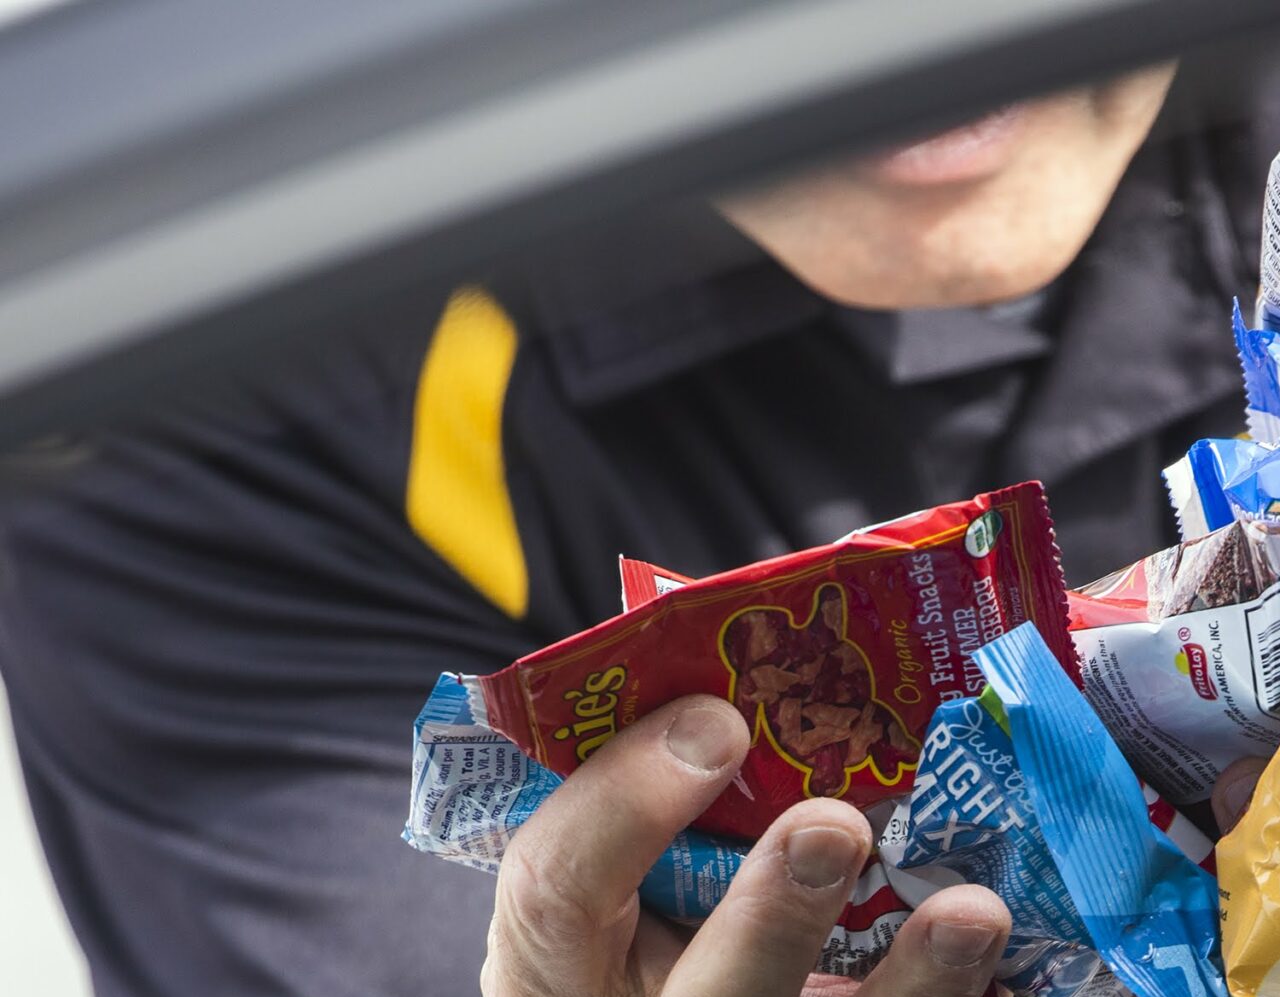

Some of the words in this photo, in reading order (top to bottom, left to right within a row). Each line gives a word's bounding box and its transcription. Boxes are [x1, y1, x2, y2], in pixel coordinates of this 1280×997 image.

[916, 552, 946, 622] Snacks
[927, 623, 954, 688] Fruit
[950, 607, 989, 697] SUMMER
[1212, 619, 1221, 641] INC.
[892, 617, 921, 705] Organic
[1214, 640, 1231, 697] AMERICA,
[462, 748, 475, 775] Total
[495, 747, 506, 776] source
[948, 701, 1002, 781] Just
[922, 723, 1026, 851] RIGHT
[1027, 852, 1046, 871] ALL
[1037, 864, 1065, 896] RIGHT
[1033, 889, 1063, 923] GIVES
[1055, 916, 1076, 939] YOU
